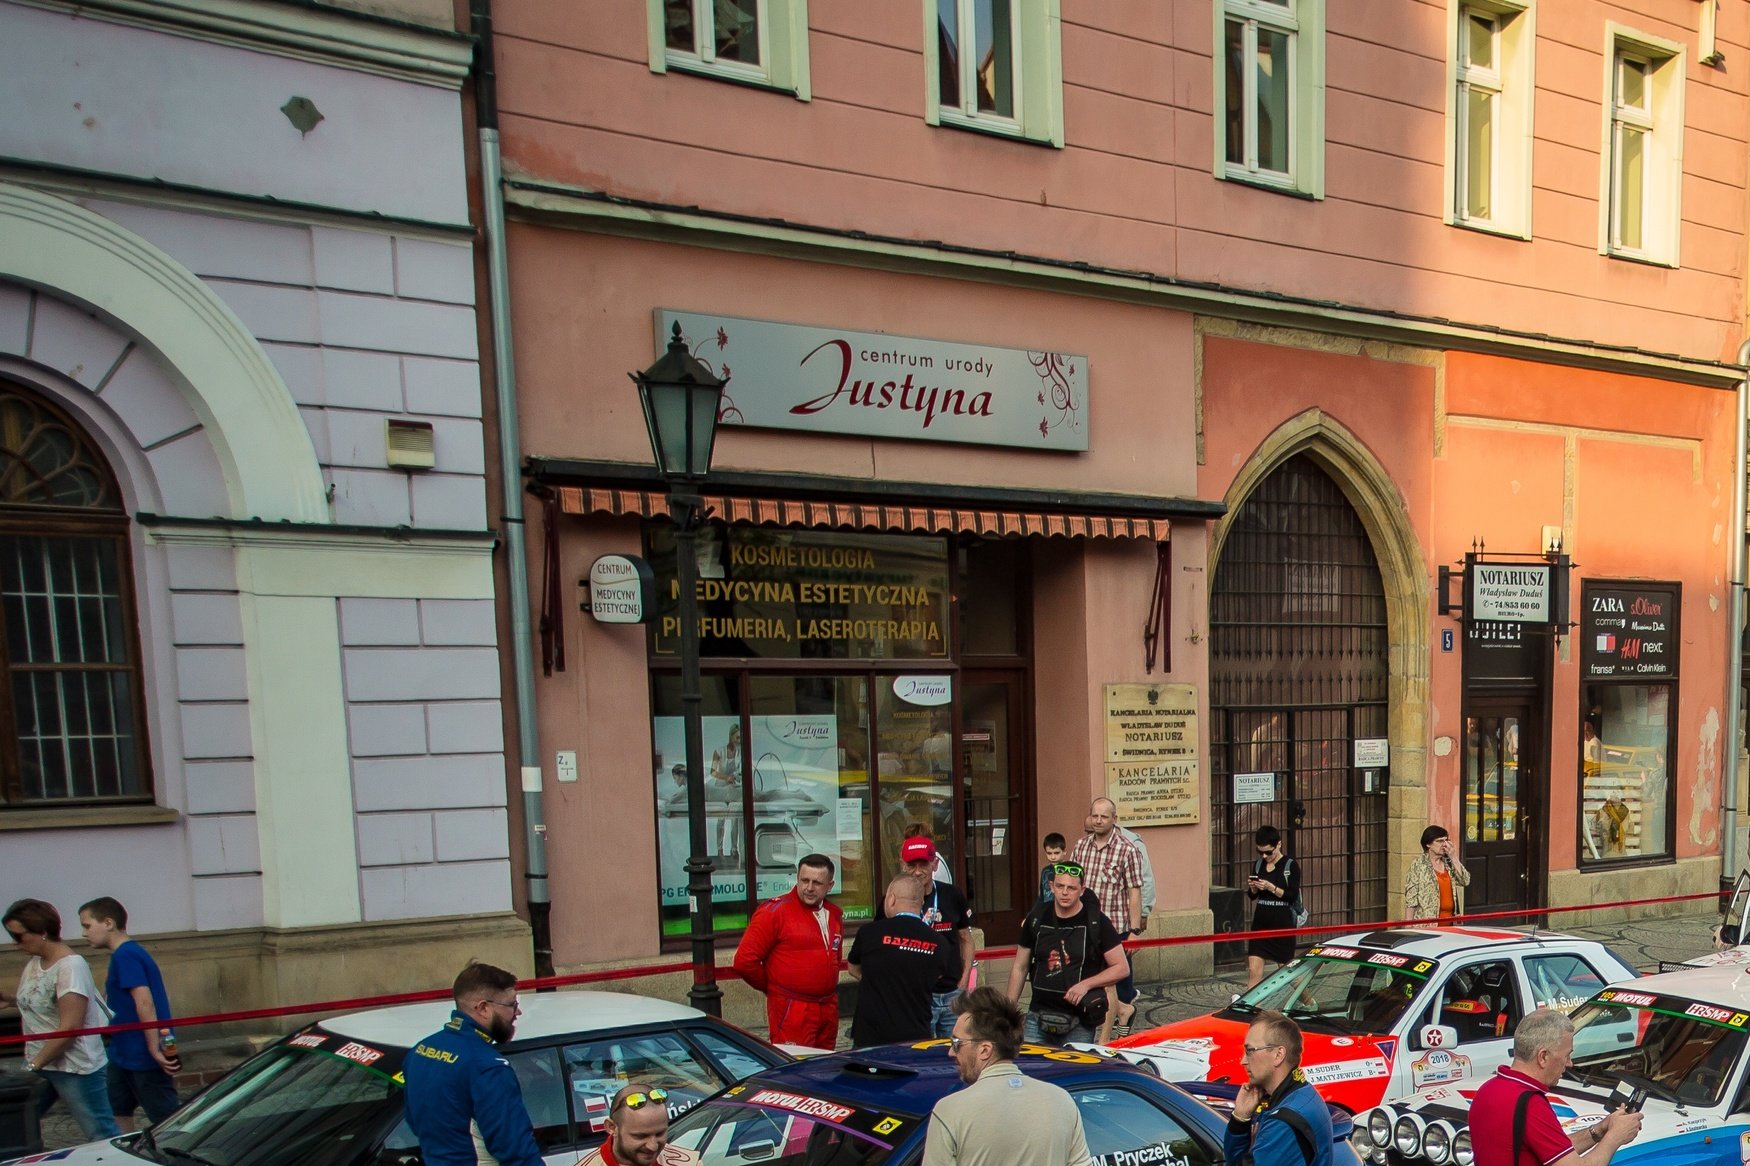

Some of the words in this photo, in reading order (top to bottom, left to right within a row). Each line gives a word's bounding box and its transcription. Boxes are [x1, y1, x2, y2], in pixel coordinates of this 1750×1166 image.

[861, 350, 933, 367] centrum
[946, 357, 993, 377] urody
[789, 339, 994, 429] Justyna
[731, 545, 875, 570] KOSMETOLOGIA
[597, 564, 632, 576] CENTRUM
[1480, 570, 1544, 586] NOTARIUSZ
[596, 589, 636, 601] MEDYCYNY
[800, 582, 929, 606] ESTETYCZNA
[594, 602, 640, 617] ESTETYCZNEJ
[1593, 598, 1624, 613] ZARA
[797, 621, 940, 641] LASEROTERAPIA
[1445, 633, 1451, 648] 5
[1643, 641, 1663, 653] next
[1637, 663, 1651, 672] Calvin
[1652, 664, 1666, 672] Klein
[903, 680, 946, 697] Justyna
[783, 720, 829, 739] Justyna
[1125, 732, 1183, 742] NOTARIUSZ
[1119, 766, 1190, 778] KANCELARIA
[883, 935, 938, 951] GAZMOT
[1320, 948, 1356, 958] MOTUL
[1612, 992, 1655, 1006] MOTUL
[416, 1045, 459, 1064] SUBARU
[1431, 1055, 1449, 1064] 2018
[1307, 1064, 1341, 1075] M.SUDER
[1310, 1071, 1363, 1083] J.MATYJEWICZ
[753, 1090, 803, 1109] MOTUL
